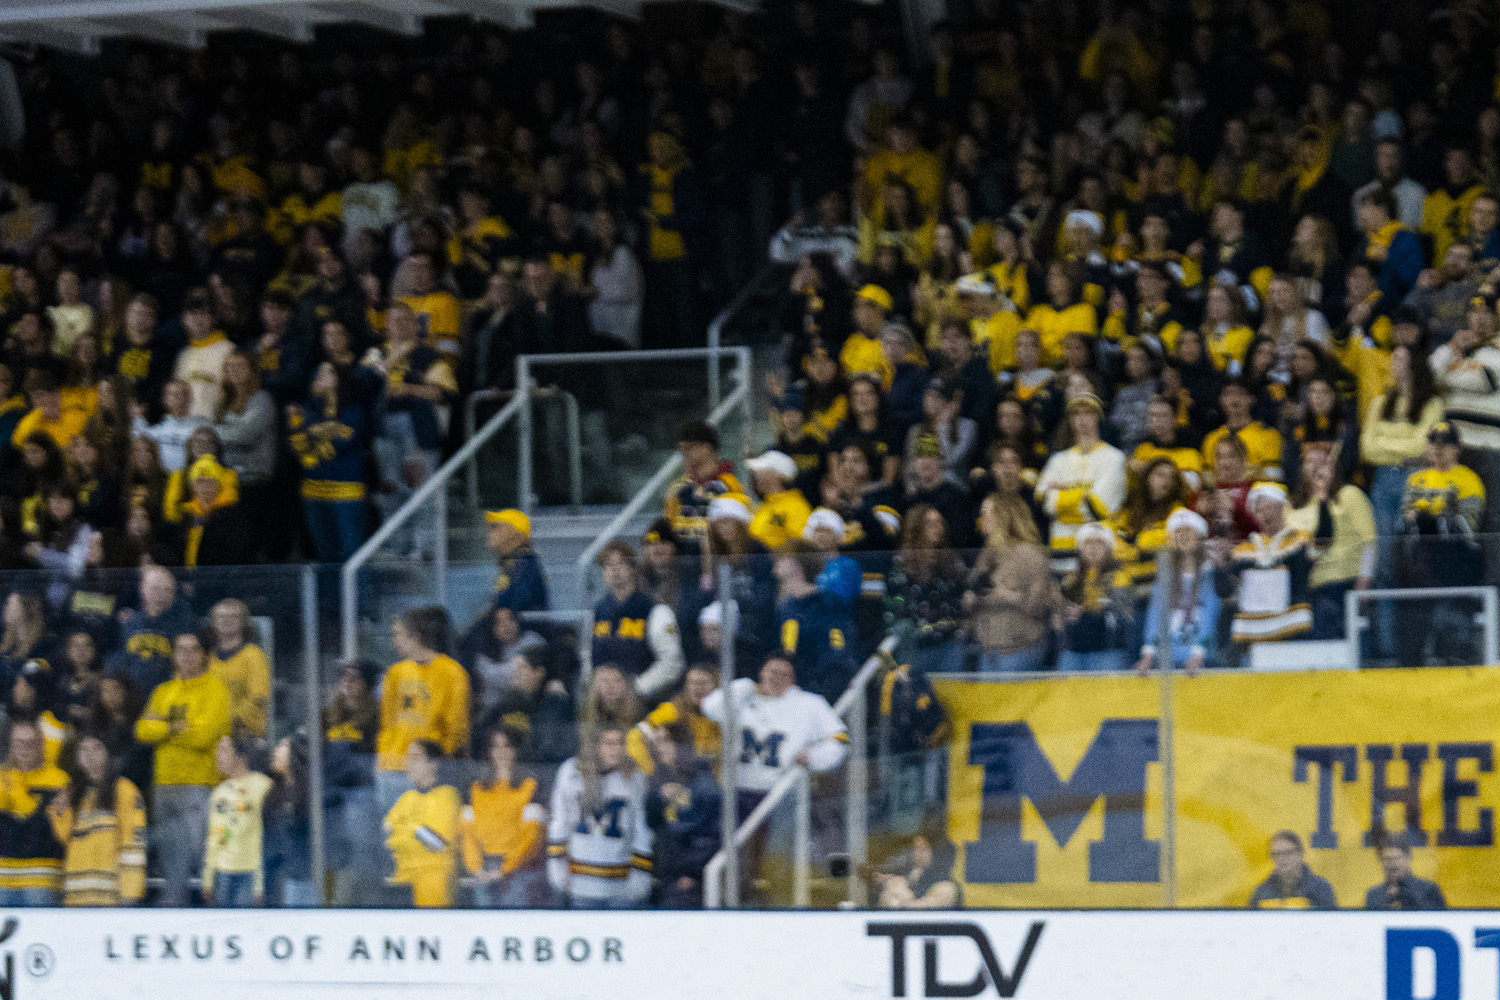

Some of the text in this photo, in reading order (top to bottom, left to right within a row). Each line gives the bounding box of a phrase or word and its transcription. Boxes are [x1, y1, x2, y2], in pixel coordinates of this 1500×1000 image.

[741, 728, 785, 767] M
[965, 718, 1160, 883] M
[1293, 741, 1494, 849] THE
[105, 935, 625, 962] LEXUS OF ANN ARBOR
[866, 920, 1046, 998] TDV
